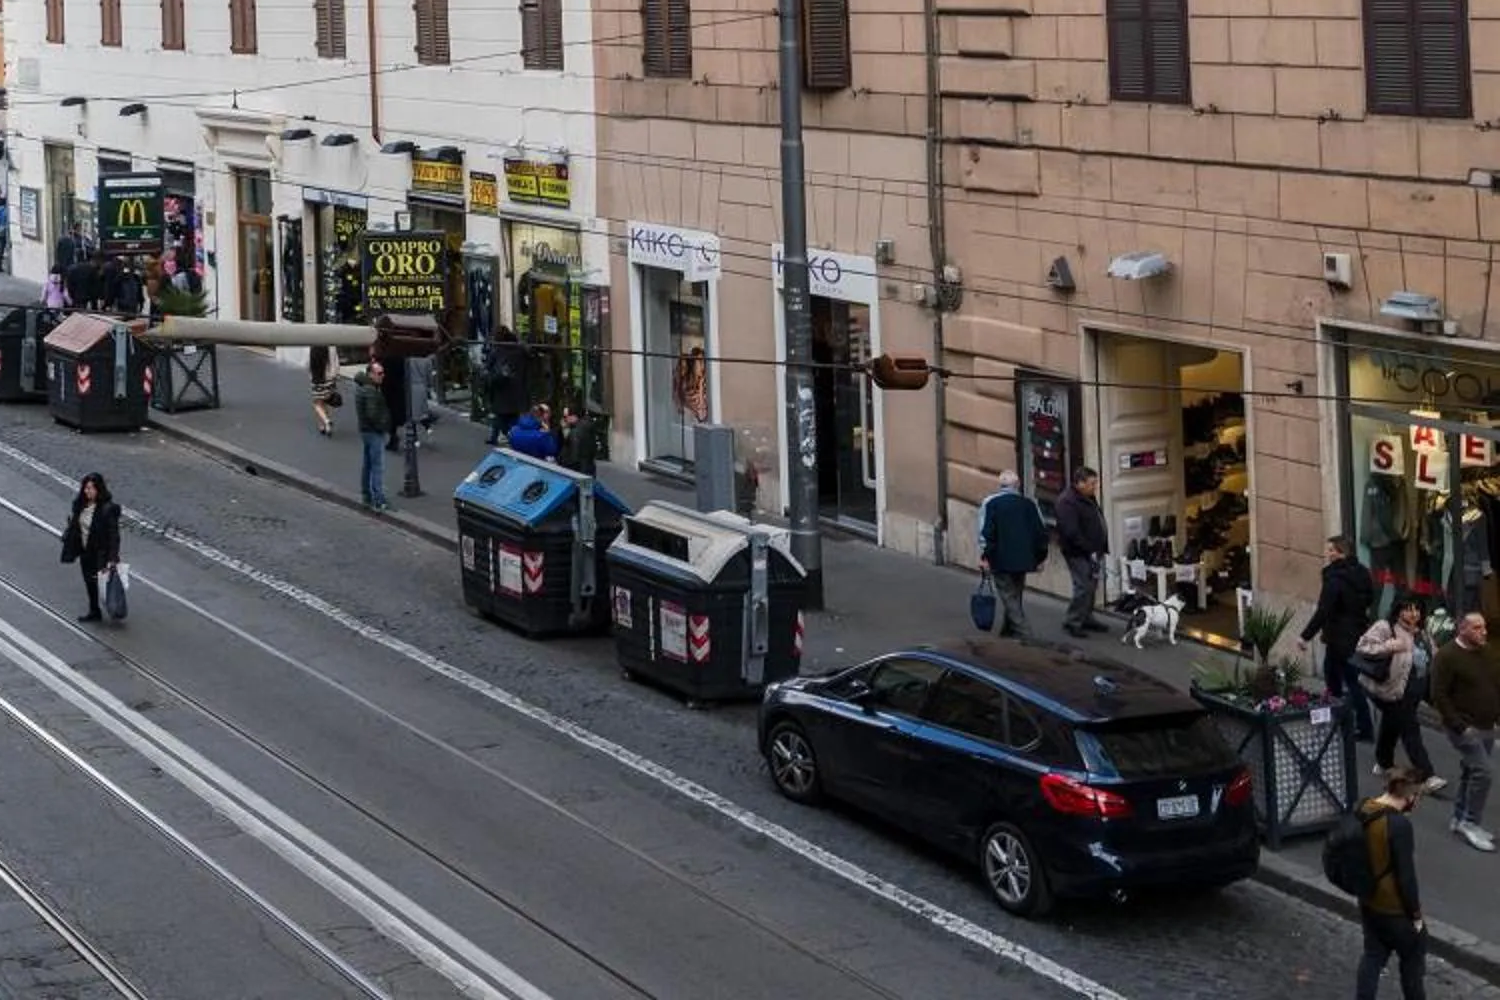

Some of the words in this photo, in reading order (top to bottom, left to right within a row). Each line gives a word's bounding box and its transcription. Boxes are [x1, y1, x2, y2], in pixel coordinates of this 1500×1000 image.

[368, 240, 441, 255] COMPRO
[631, 227, 686, 257] KIKO
[375, 253, 436, 275] ORO
[367, 285, 387, 297] Via
